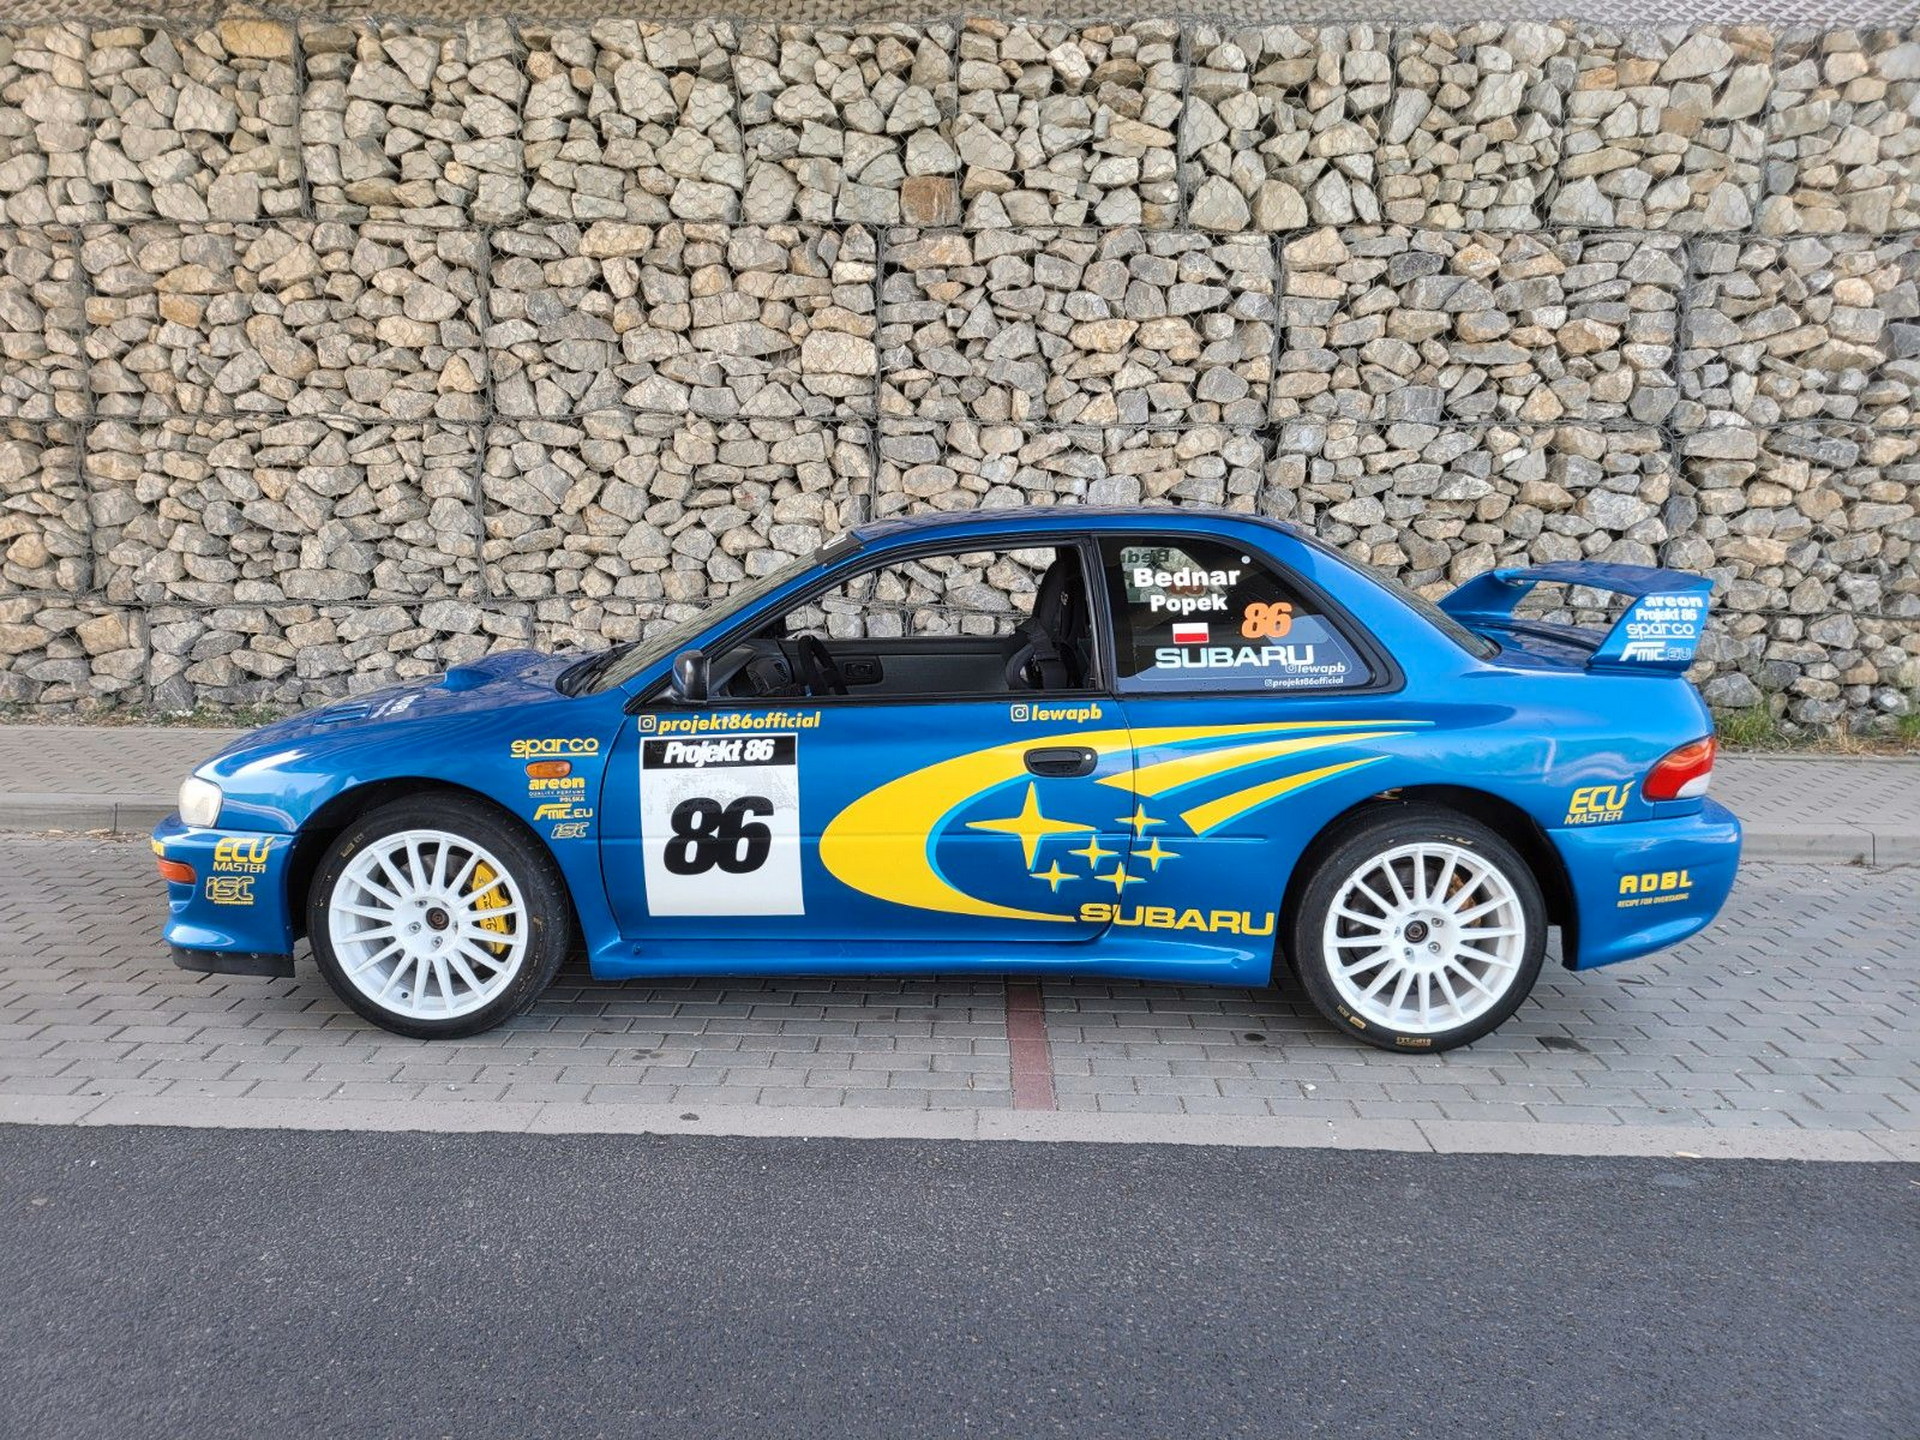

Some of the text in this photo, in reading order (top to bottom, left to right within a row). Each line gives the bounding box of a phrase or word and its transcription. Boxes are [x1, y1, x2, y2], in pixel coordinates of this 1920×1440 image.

[1133, 568, 1241, 588] Bednar
[1150, 595, 1228, 615] Popek
[1644, 596, 1703, 608] areon
[1241, 602, 1293, 639] 86
[1635, 609, 1697, 622] Projekt 86
[1626, 623, 1695, 640] sparco
[1155, 645, 1314, 669] SUBARU
[1298, 662, 1346, 676] lewapb
[1272, 676, 1344, 688] projekt86official
[658, 711, 821, 735] projekt86official
[1031, 704, 1102, 723] lewapb
[510, 738, 599, 760] sparco
[663, 739, 776, 767] Projekt 86
[528, 777, 585, 790] areon
[560, 795, 585, 803] POLSKA
[1569, 781, 1636, 814] ECU
[1564, 810, 1624, 825] MASTER
[663, 795, 775, 876] 86
[214, 836, 275, 864] ECU
[212, 861, 267, 874] MASTER
[1619, 870, 1694, 894] ADBL
[1080, 903, 1275, 936] SUBARU
